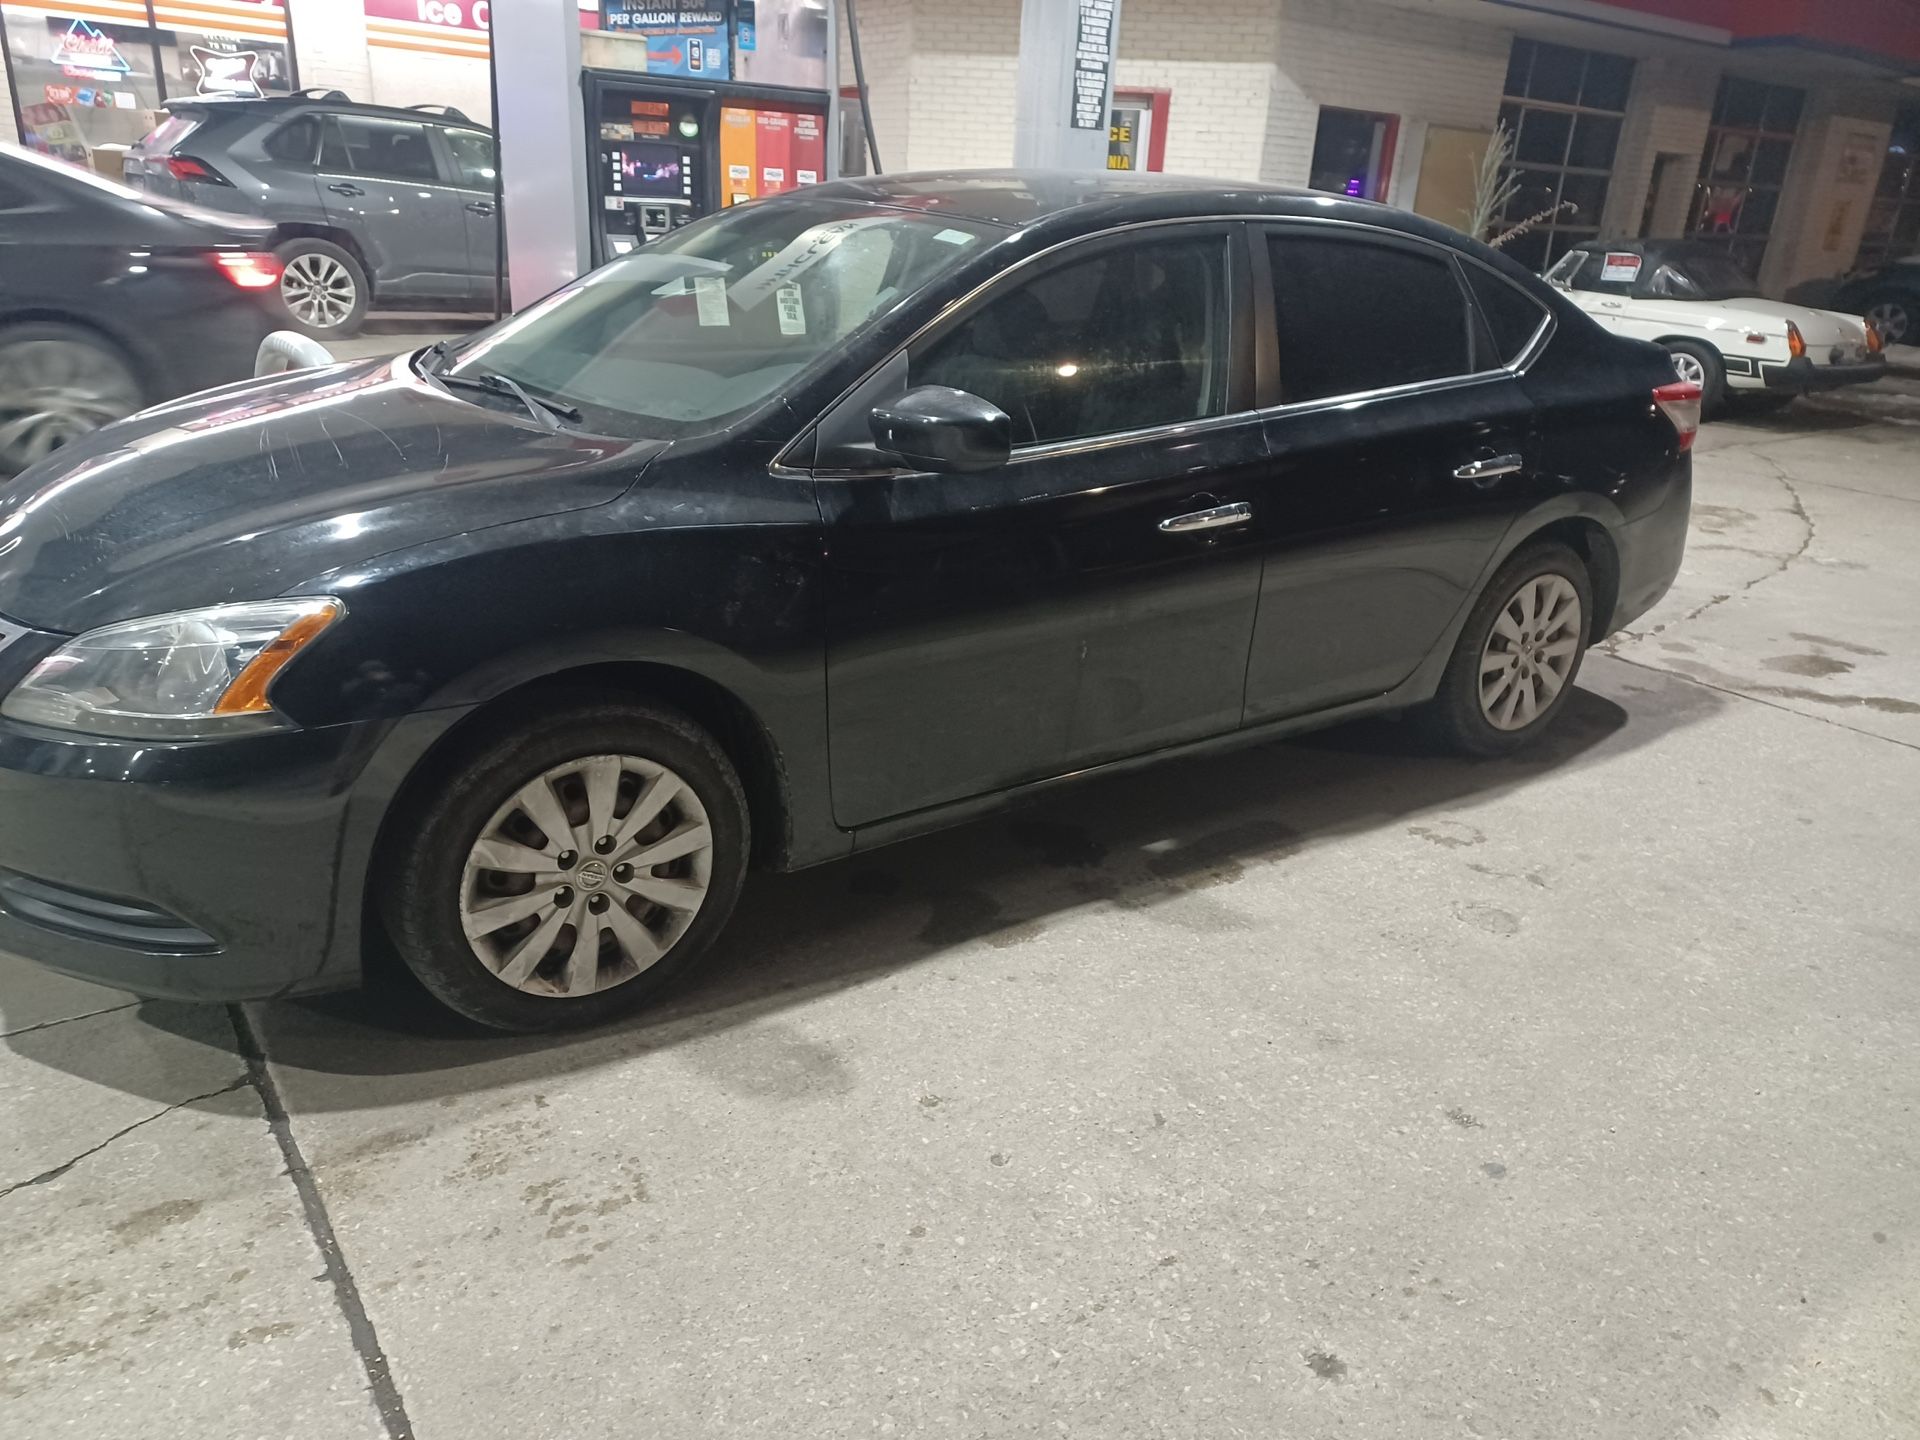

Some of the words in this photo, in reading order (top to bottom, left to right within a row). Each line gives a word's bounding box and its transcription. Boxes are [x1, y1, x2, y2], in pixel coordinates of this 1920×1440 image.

[417, 0, 462, 25] Ice
[610, 13, 629, 24] PER
[633, 12, 676, 24] GALLON
[680, 12, 722, 23] REWARD
